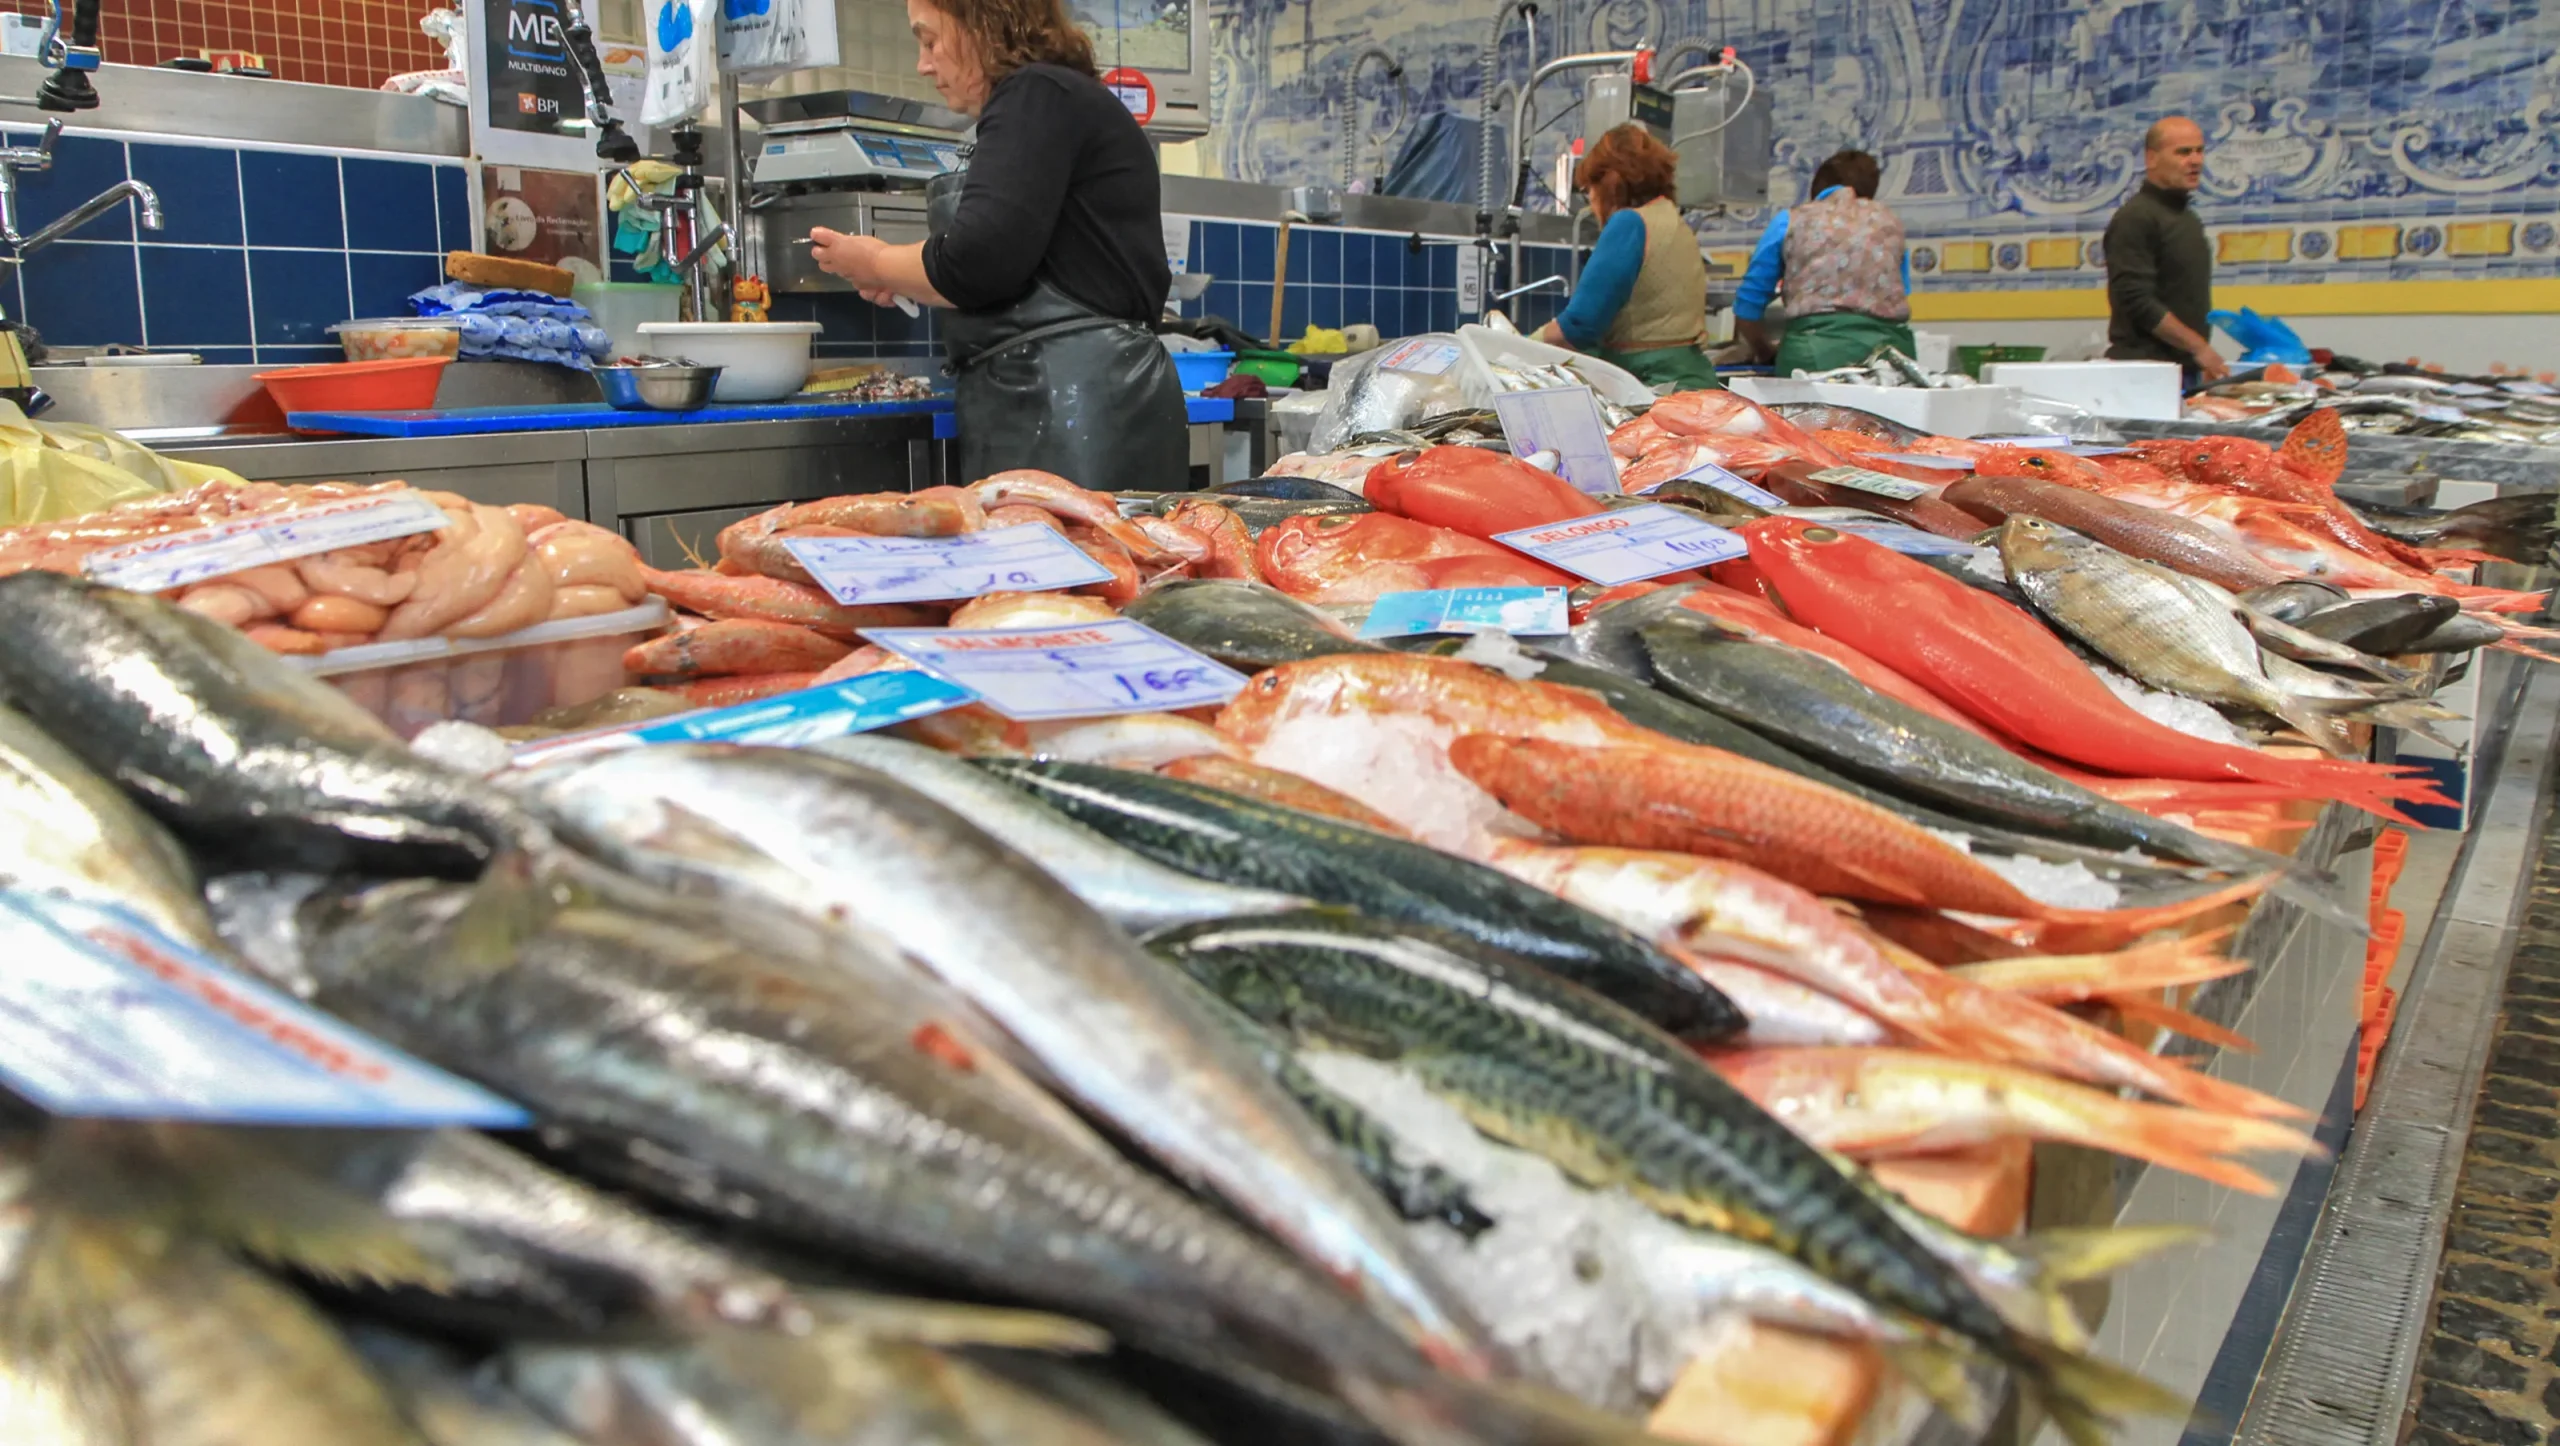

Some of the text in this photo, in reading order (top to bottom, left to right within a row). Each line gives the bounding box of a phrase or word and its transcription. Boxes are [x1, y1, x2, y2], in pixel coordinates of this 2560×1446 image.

[508, 60, 568, 77] MULTIBANCO
[537, 98, 560, 113] BPI
[1530, 518, 1630, 544] SELONGO
[934, 629, 1113, 652] SALMONETE
